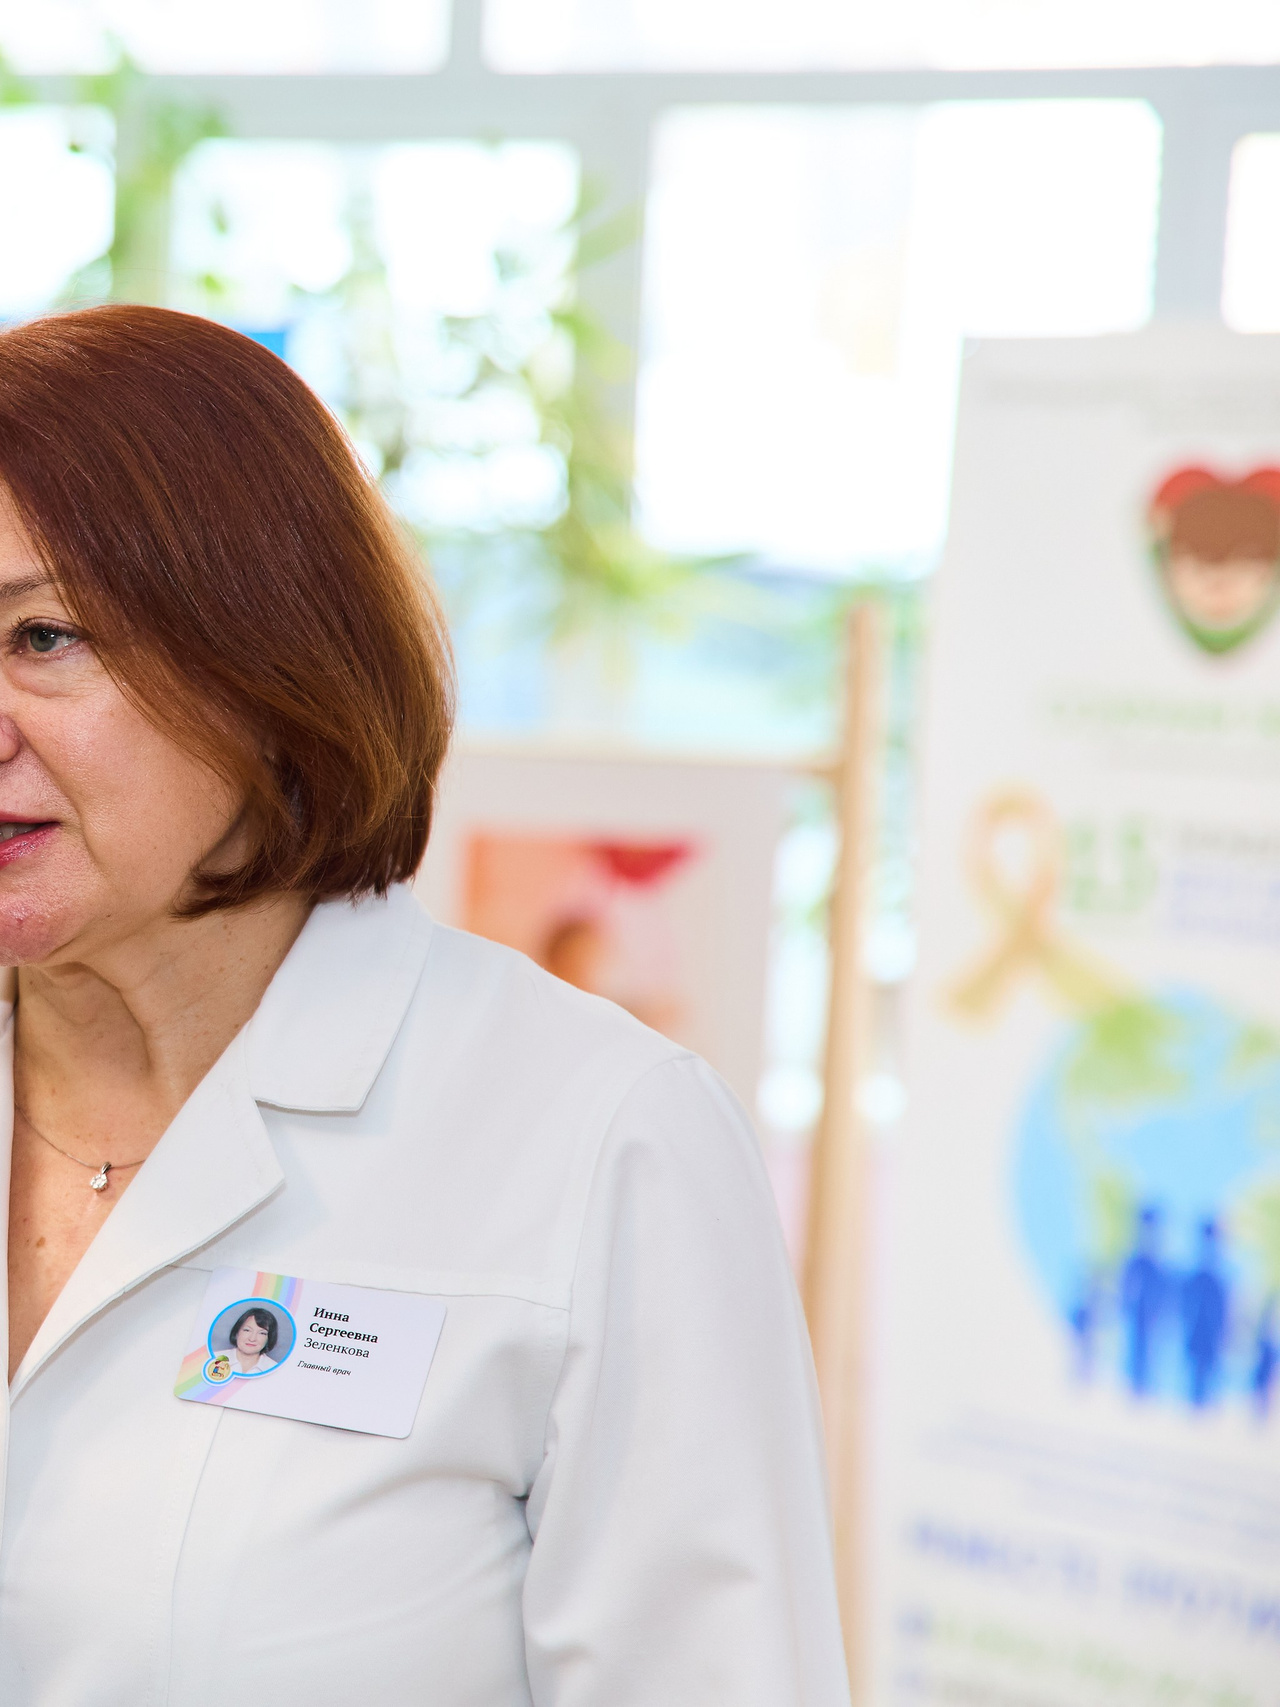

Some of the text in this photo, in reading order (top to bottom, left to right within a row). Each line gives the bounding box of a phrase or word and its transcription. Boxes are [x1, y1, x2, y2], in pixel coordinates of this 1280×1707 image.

[313, 1306, 350, 1322] Инна
[309, 1322, 378, 1343] Сергеевна
[303, 1337, 370, 1358] Зеленкова
[297, 1360, 351, 1376] Главный врач
